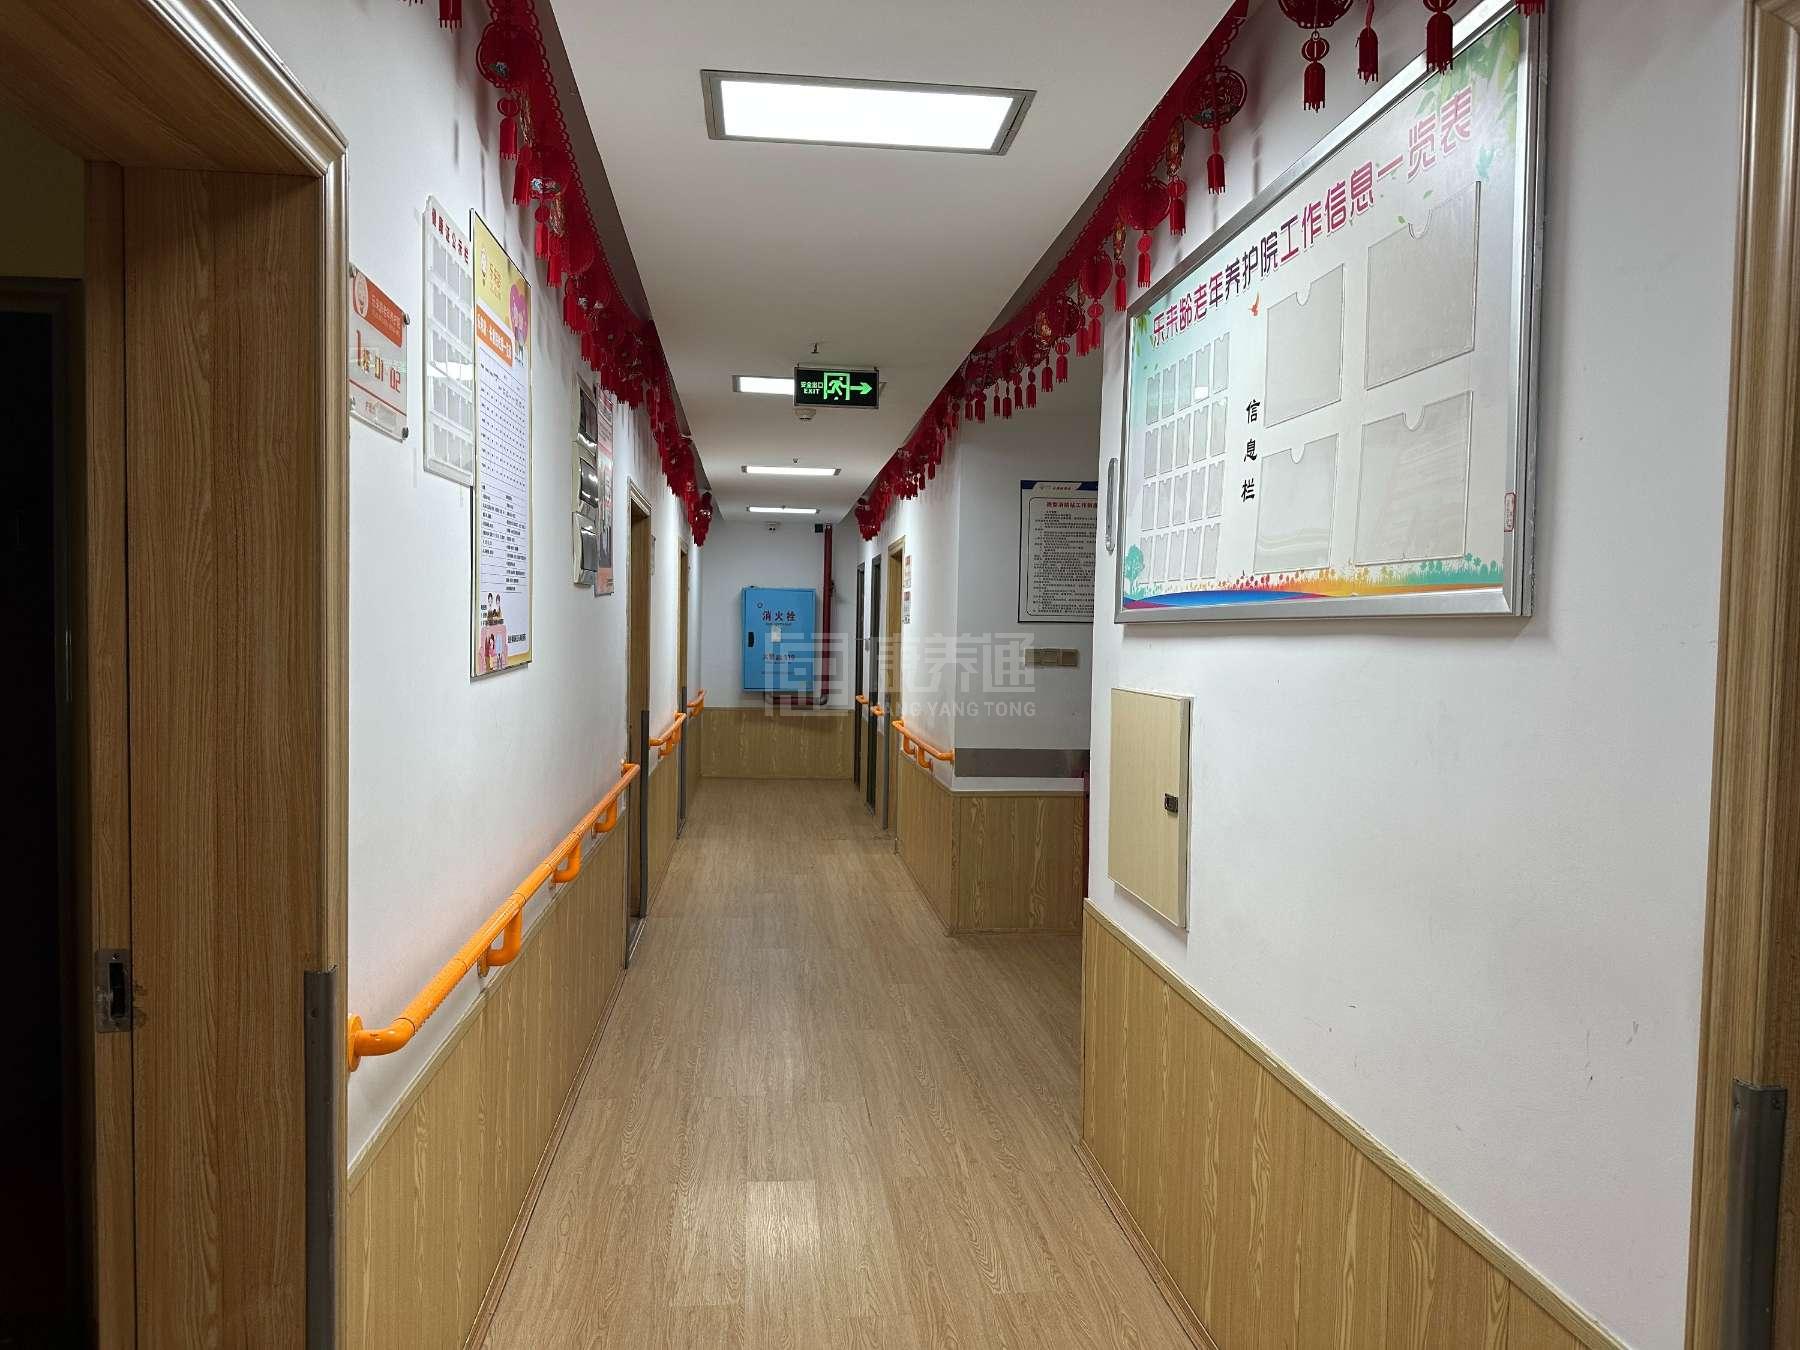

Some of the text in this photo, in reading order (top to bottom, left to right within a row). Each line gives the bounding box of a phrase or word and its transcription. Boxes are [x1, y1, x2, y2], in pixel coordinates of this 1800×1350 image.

[800, 381, 823, 389] 安全出口
[1240, 398, 1261, 503] 信息栏
[762, 609, 797, 622] 消火栓
